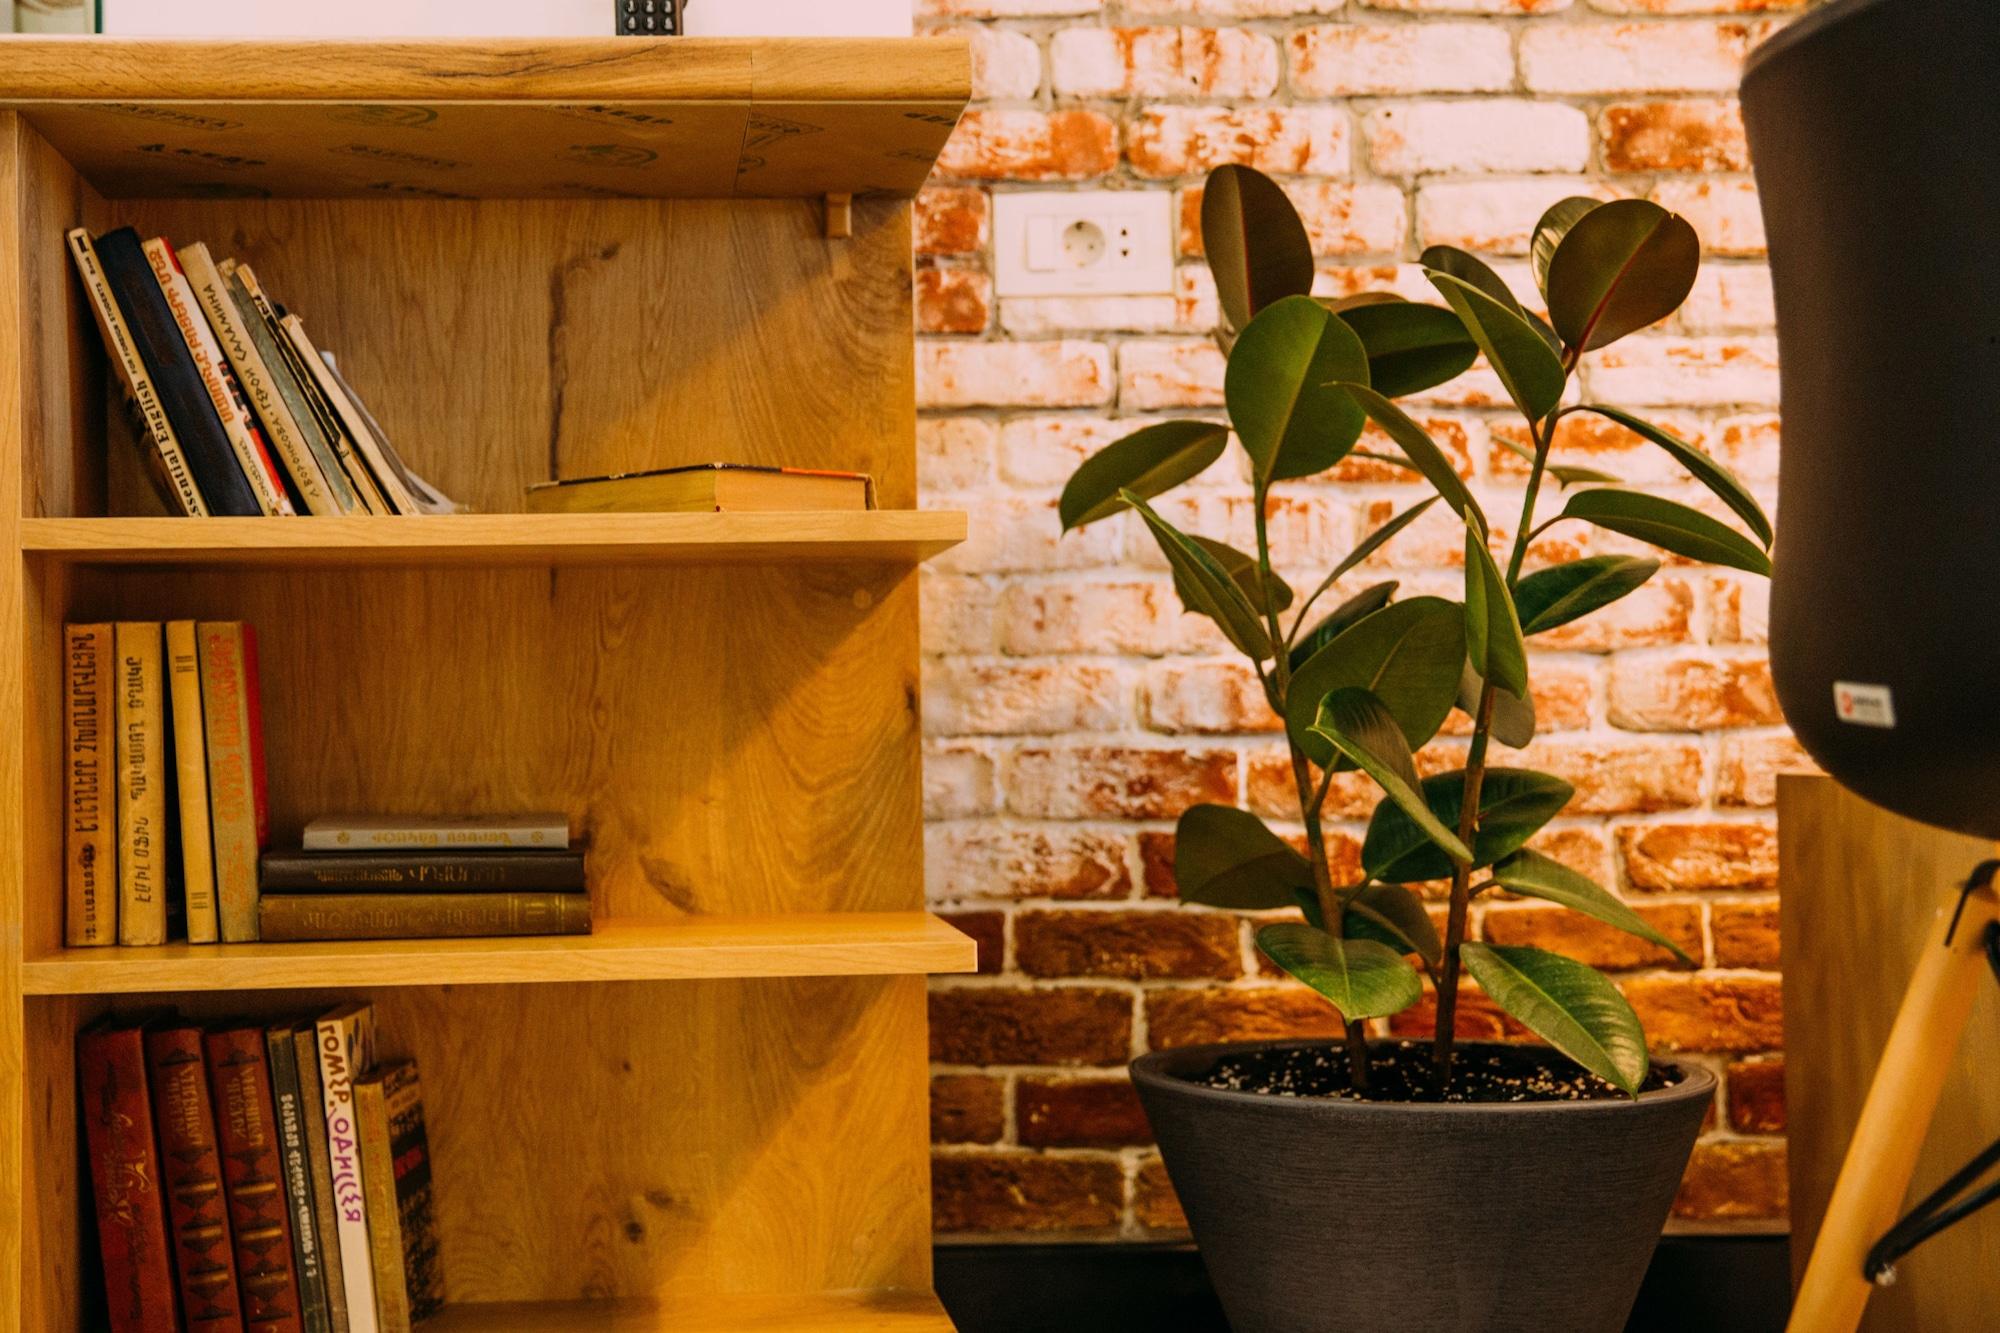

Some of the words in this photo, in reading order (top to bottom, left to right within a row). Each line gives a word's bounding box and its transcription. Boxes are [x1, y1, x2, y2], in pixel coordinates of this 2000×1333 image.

[149, 249, 173, 285] ՄԵՋ
[96, 282, 116, 323] STUDENTS
[203, 283, 247, 362] САЛАМИНА
[127, 359, 138, 374] FOR
[136, 380, 170, 443] English
[164, 448, 202, 517] ssential
[270, 417, 314, 488] ВОРОНКОВА
[135, 863, 151, 903] ԷՄԻԼ
[333, 1117, 363, 1222] ОДИССЕЯ
